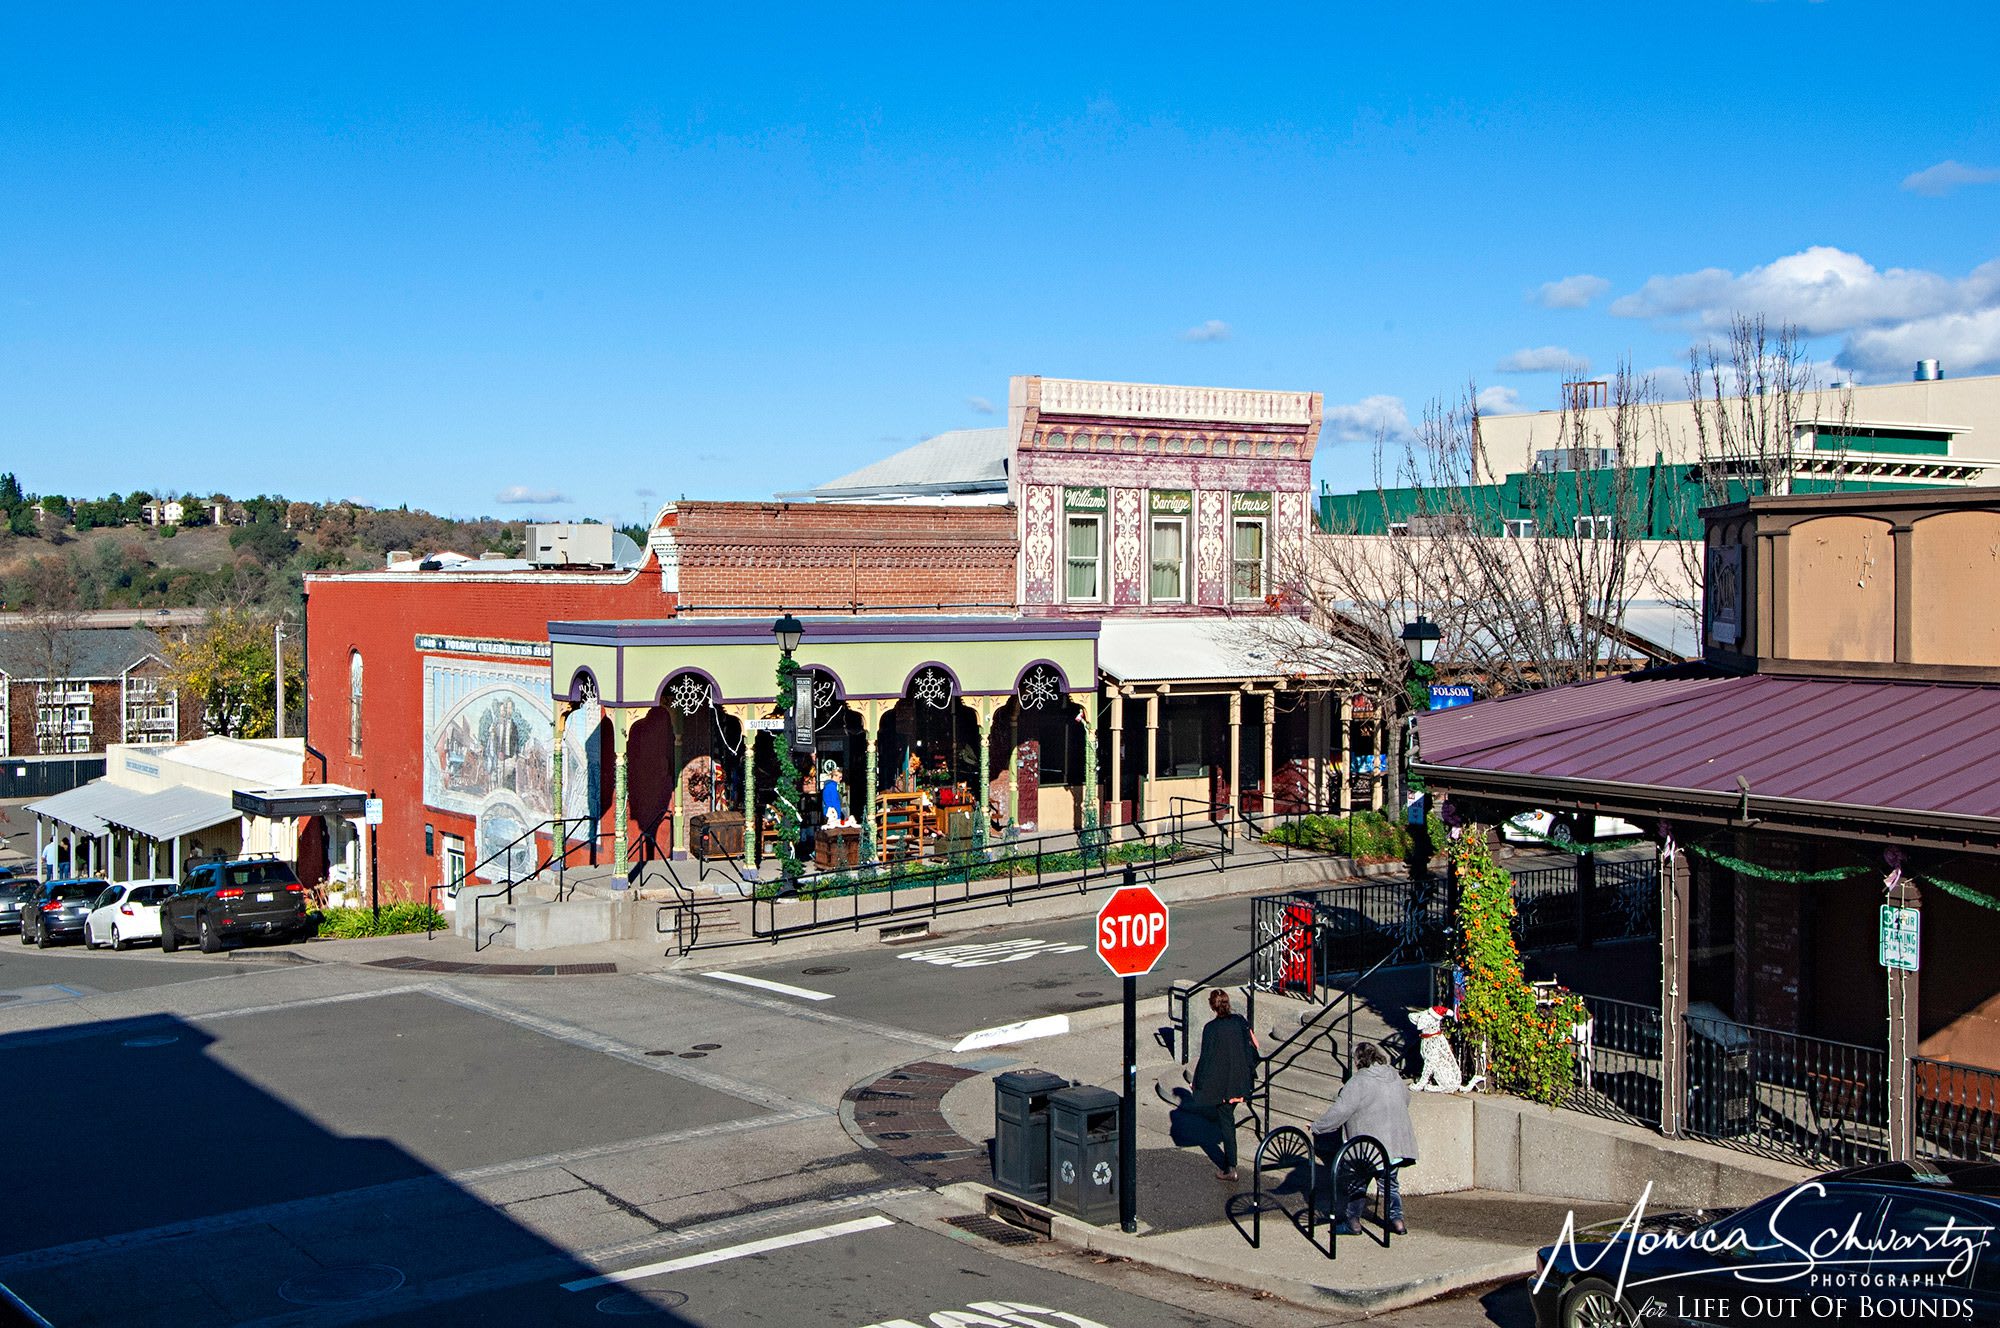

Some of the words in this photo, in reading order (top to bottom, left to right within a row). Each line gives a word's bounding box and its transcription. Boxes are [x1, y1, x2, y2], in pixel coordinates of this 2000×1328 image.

[1152, 494, 1190, 513] Carriage
[1232, 493, 1270, 511] House
[445, 640, 477, 651] FOLSOM
[478, 643, 532, 656] CELEBRATES
[1433, 687, 1470, 697] FOLSOM
[750, 720, 770, 728] SUTTER
[772, 720, 779, 728] ST
[1101, 912, 1164, 950] STOP
